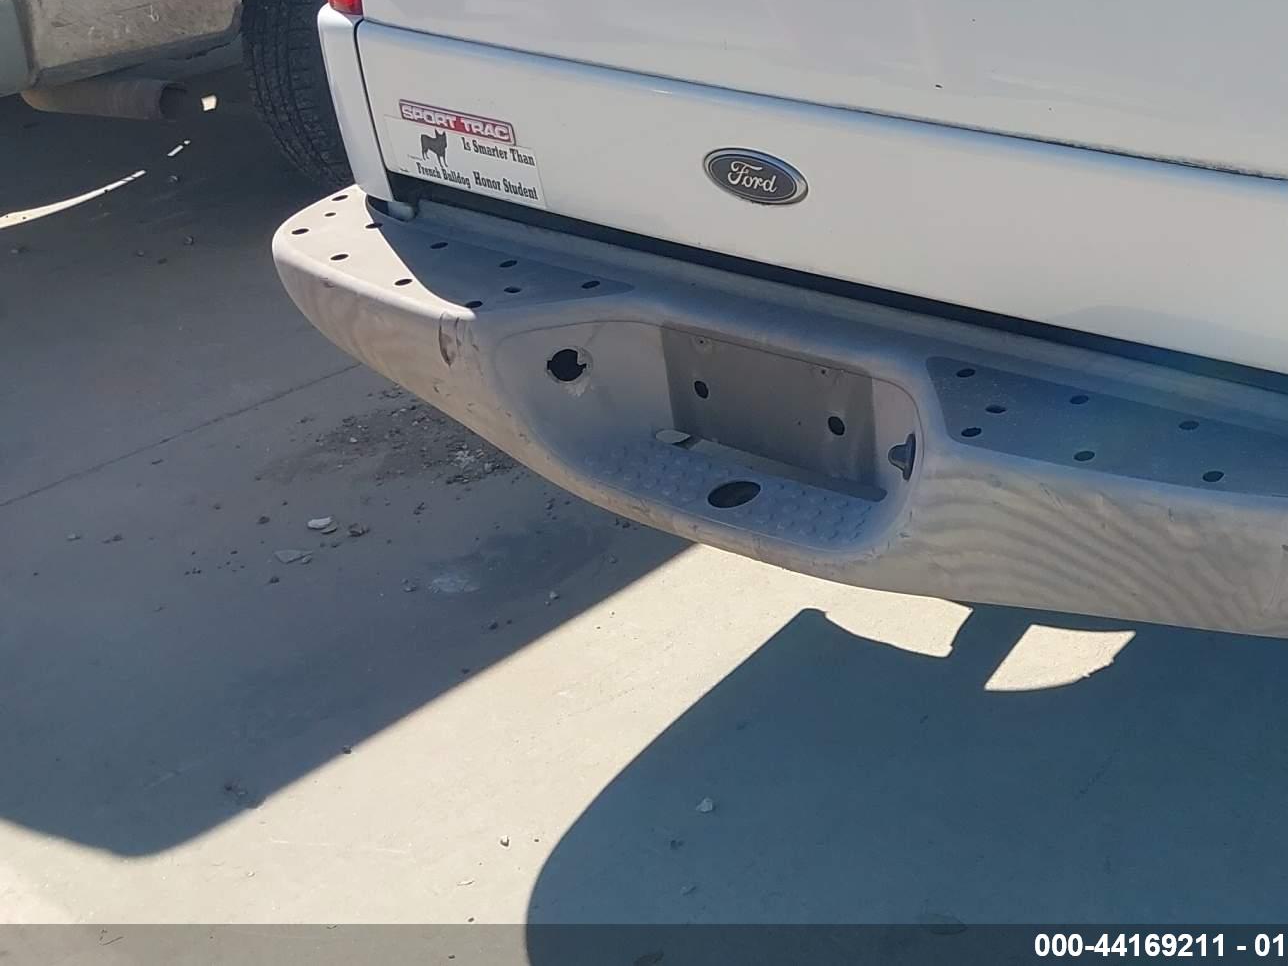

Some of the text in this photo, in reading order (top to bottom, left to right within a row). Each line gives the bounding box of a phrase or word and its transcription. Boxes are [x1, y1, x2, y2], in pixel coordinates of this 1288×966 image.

[401, 104, 511, 141] SPORT TRAC
[461, 137, 536, 167] Is Smarter Than
[416, 162, 539, 200] French Bulldog Honor Student
[728, 160, 778, 193] Ford
